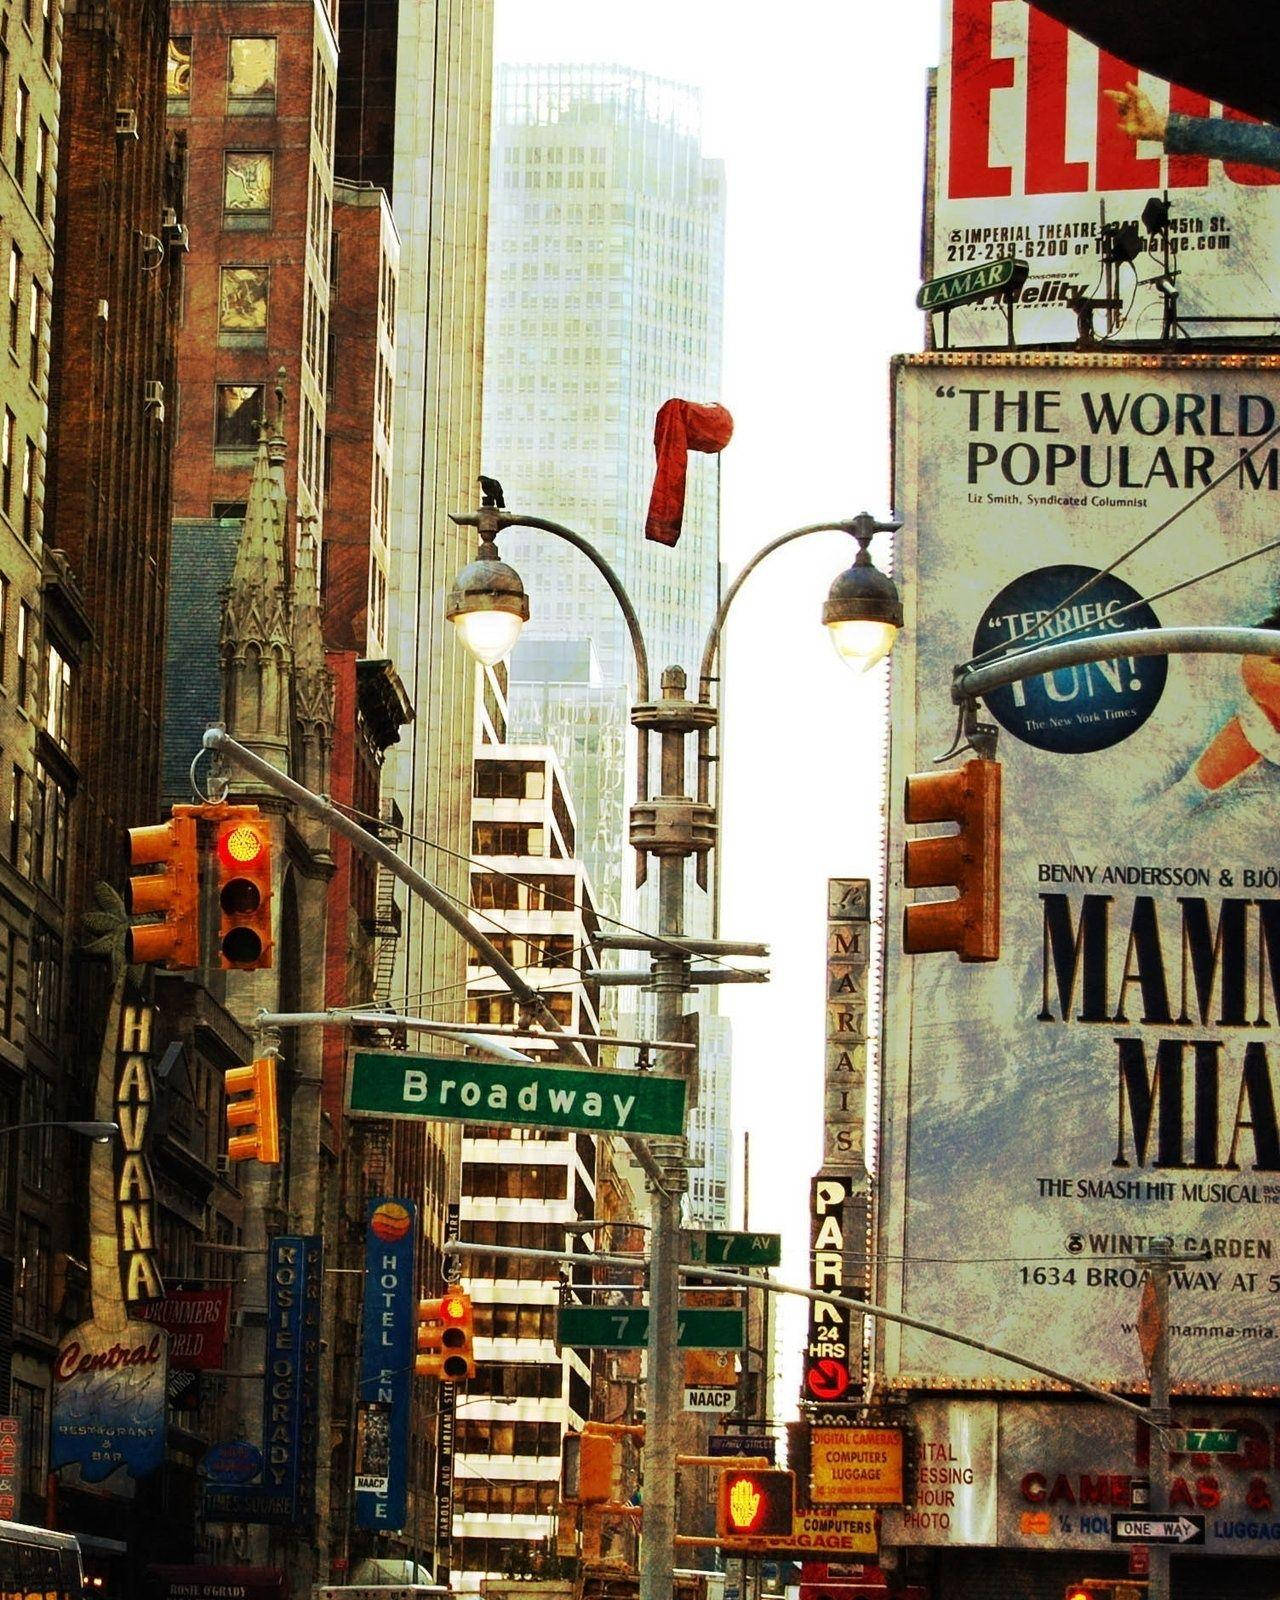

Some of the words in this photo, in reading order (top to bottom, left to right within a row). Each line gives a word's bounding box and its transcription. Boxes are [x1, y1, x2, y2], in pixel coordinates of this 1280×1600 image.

[965, 226, 1030, 244] IMPERIAL
[1039, 222, 1097, 239] THEATRE
[1210, 216, 1231, 231] St.
[947, 240, 1068, 262] 212-239-6200
[1075, 245, 1089, 256] or
[922, 266, 1004, 307] LAMAR
[1081, 391, 1275, 438] WORLD
[968, 442, 1218, 490] POPULAR
[968, 493, 983, 504] Liz
[987, 493, 1023, 506] Smith,
[1027, 494, 1088, 508] Syndicated
[1091, 496, 1148, 508] Columnist
[1025, 719, 1046, 732] The
[1048, 716, 1072, 729] New
[1075, 711, 1101, 724] York
[1104, 707, 1138, 720] Times
[1038, 864, 1098, 884] BENNY
[1101, 867, 1211, 887] ANDERSSON
[1218, 870, 1234, 888] &
[1243, 866, 1280, 889] BJÖ
[833, 931, 861, 1152] MARAIS
[402, 1069, 635, 1127] Broadway
[119, 1005, 163, 1301] HAVANA
[1037, 1178, 1073, 1198] THE
[1076, 1179, 1140, 1200] SMASH
[1146, 1182, 1178, 1202] HIT
[1182, 1182, 1262, 1205] MUSICAL
[717, 1235, 735, 1261] 7
[751, 1238, 771, 1251] AV
[815, 1181, 846, 1324] PARK
[1184, 1236, 1271, 1259] GARDEN
[1020, 1266, 1077, 1286] 1634
[1086, 1267, 1223, 1291] BROAWAY
[1231, 1273, 1258, 1292] AT
[274, 1246, 297, 1350] ROSIE
[381, 1255, 398, 1347] HOTEL
[611, 1315, 631, 1341] 7
[817, 1326, 839, 1342] 24
[169, 1332, 204, 1357] ORLD
[809, 1343, 845, 1359] HRS
[55, 1333, 161, 1382] Central
[689, 1391, 732, 1408] NAACP
[813, 1432, 851, 1446] DIGITAL
[1194, 1432, 1208, 1449] 7
[825, 1450, 888, 1463] COMPUTERS
[919, 1443, 958, 1462] ITAL
[357, 1478, 385, 1488] NAACP
[831, 1467, 882, 1481] LUGGAGE
[920, 1467, 974, 1485] ESSING
[1020, 1471, 1221, 1509] CAMEAS
[803, 1517, 872, 1534] COMPUTERS
[904, 1512, 950, 1529] PHOTO
[1124, 1523, 1152, 1536] ONE
[1163, 1523, 1192, 1537] WAY
